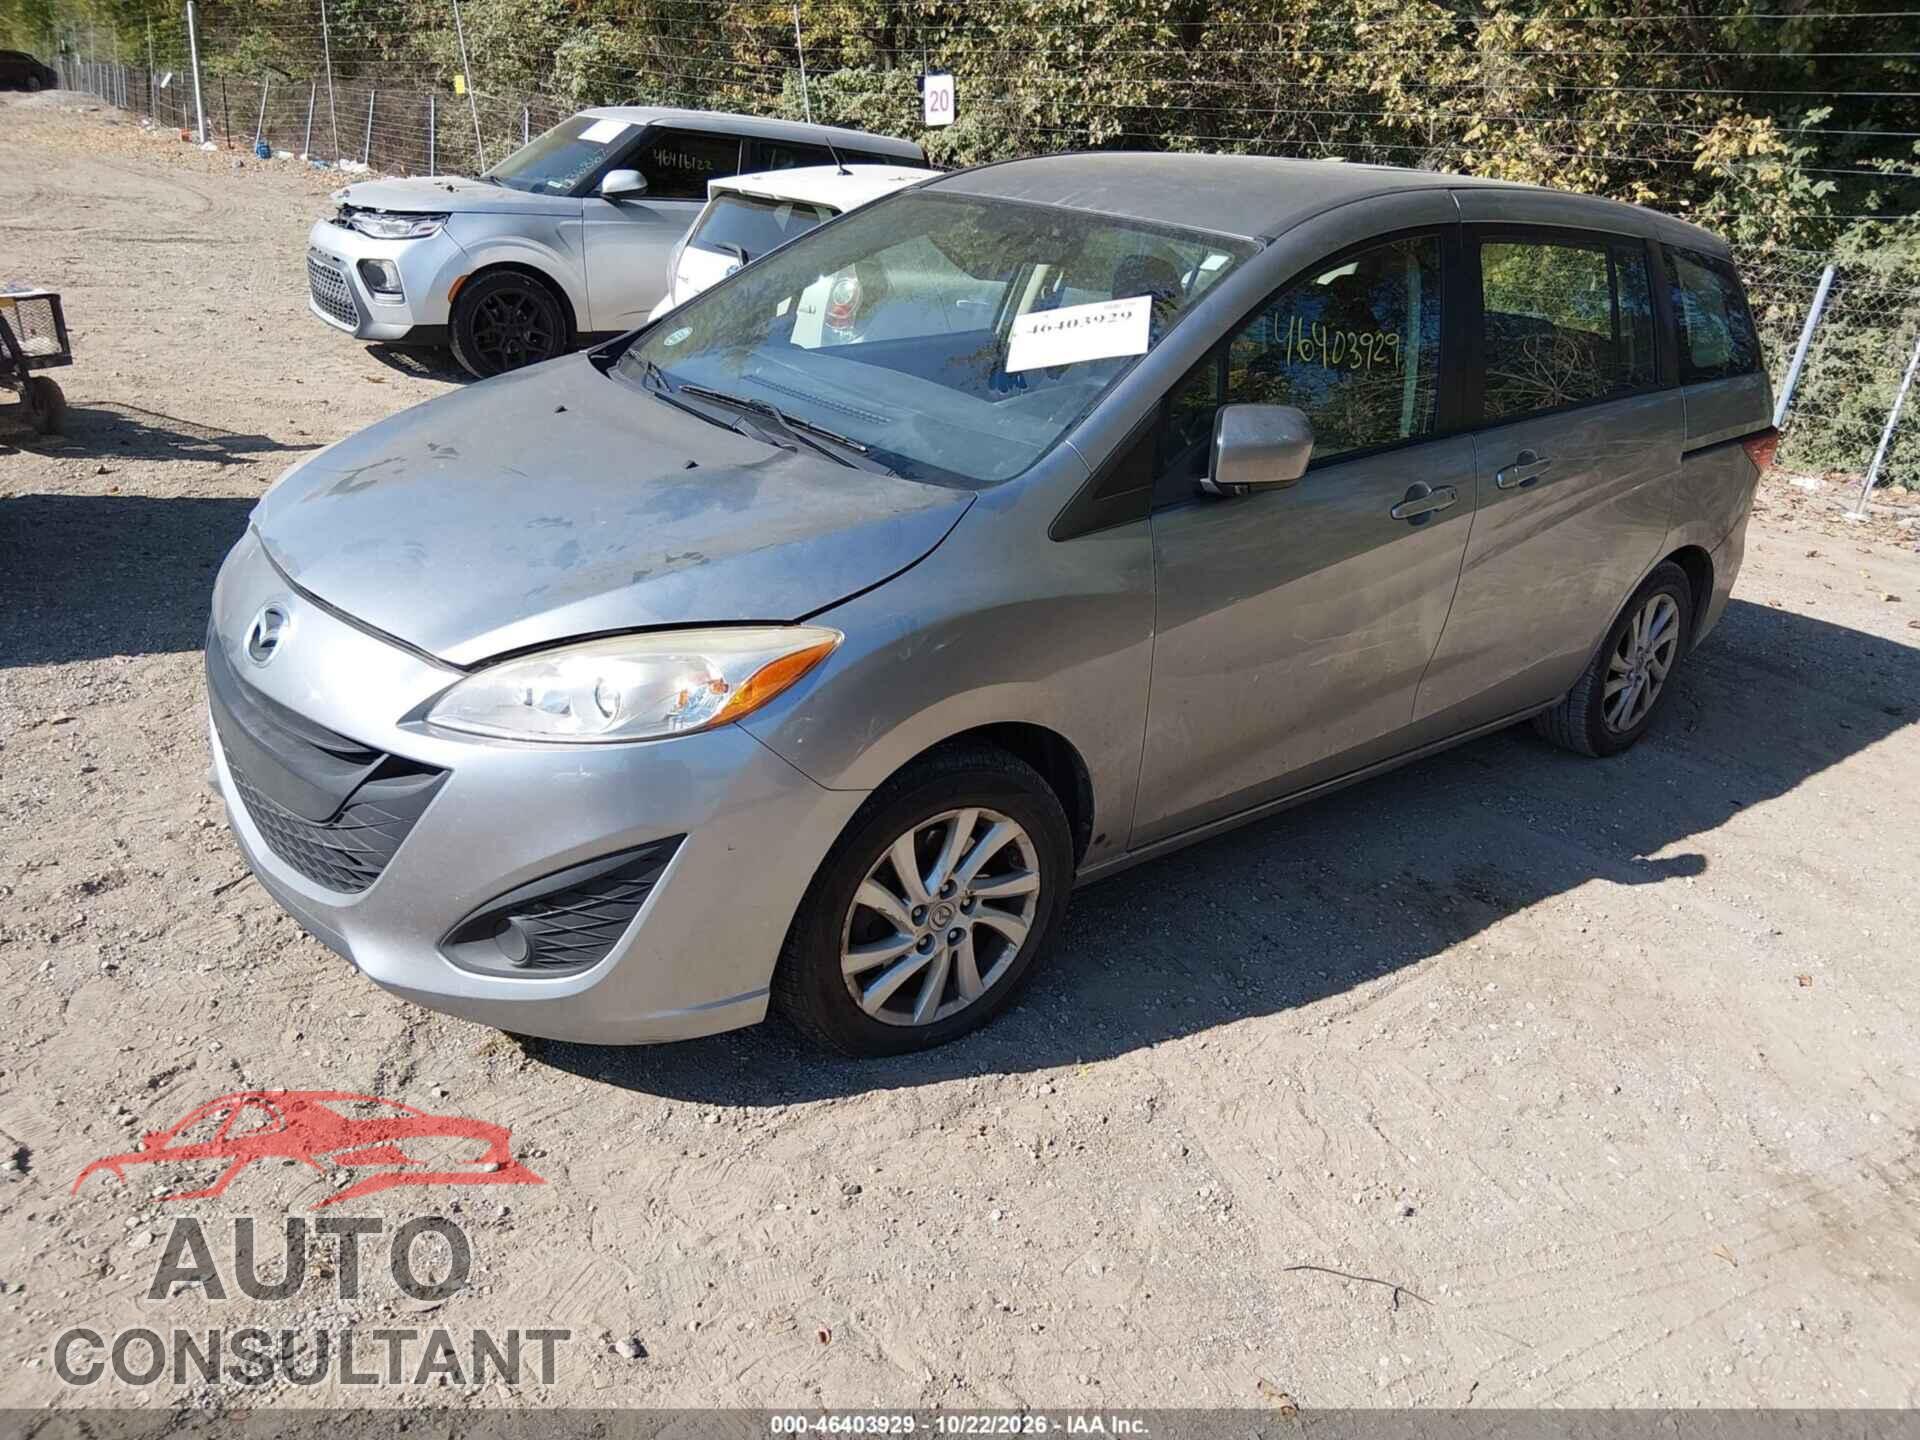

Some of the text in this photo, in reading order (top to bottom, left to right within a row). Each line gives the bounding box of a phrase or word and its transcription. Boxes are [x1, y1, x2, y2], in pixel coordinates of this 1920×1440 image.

[930, 89, 949, 112] 20
[1026, 311, 1133, 335] 46403929
[1275, 312, 1400, 370] 46403929
